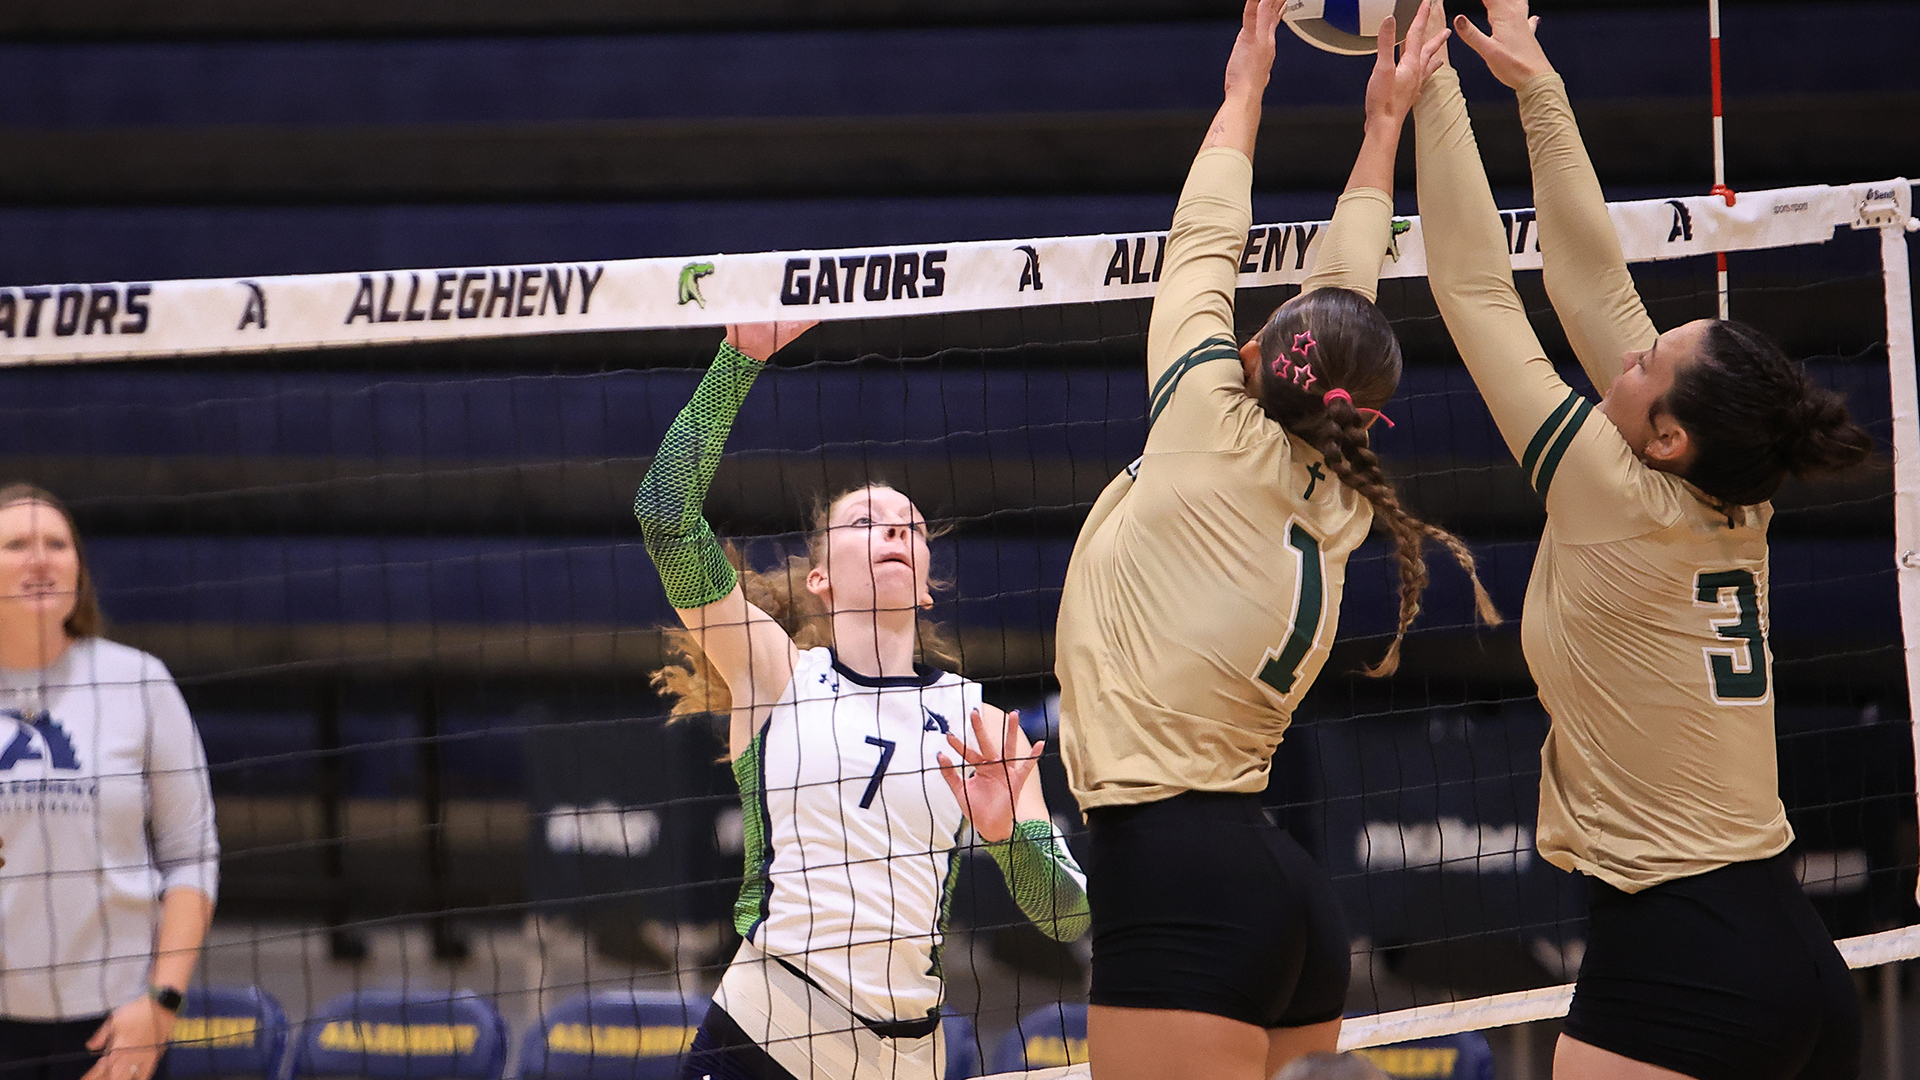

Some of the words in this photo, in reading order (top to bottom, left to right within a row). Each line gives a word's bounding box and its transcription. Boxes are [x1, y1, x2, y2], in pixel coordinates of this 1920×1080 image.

[344, 266, 604, 325] ALLEGHENY
[780, 250, 947, 305] GATORS
[1252, 512, 1327, 702] 1
[1693, 567, 1770, 706] 3
[858, 734, 896, 810] 7
